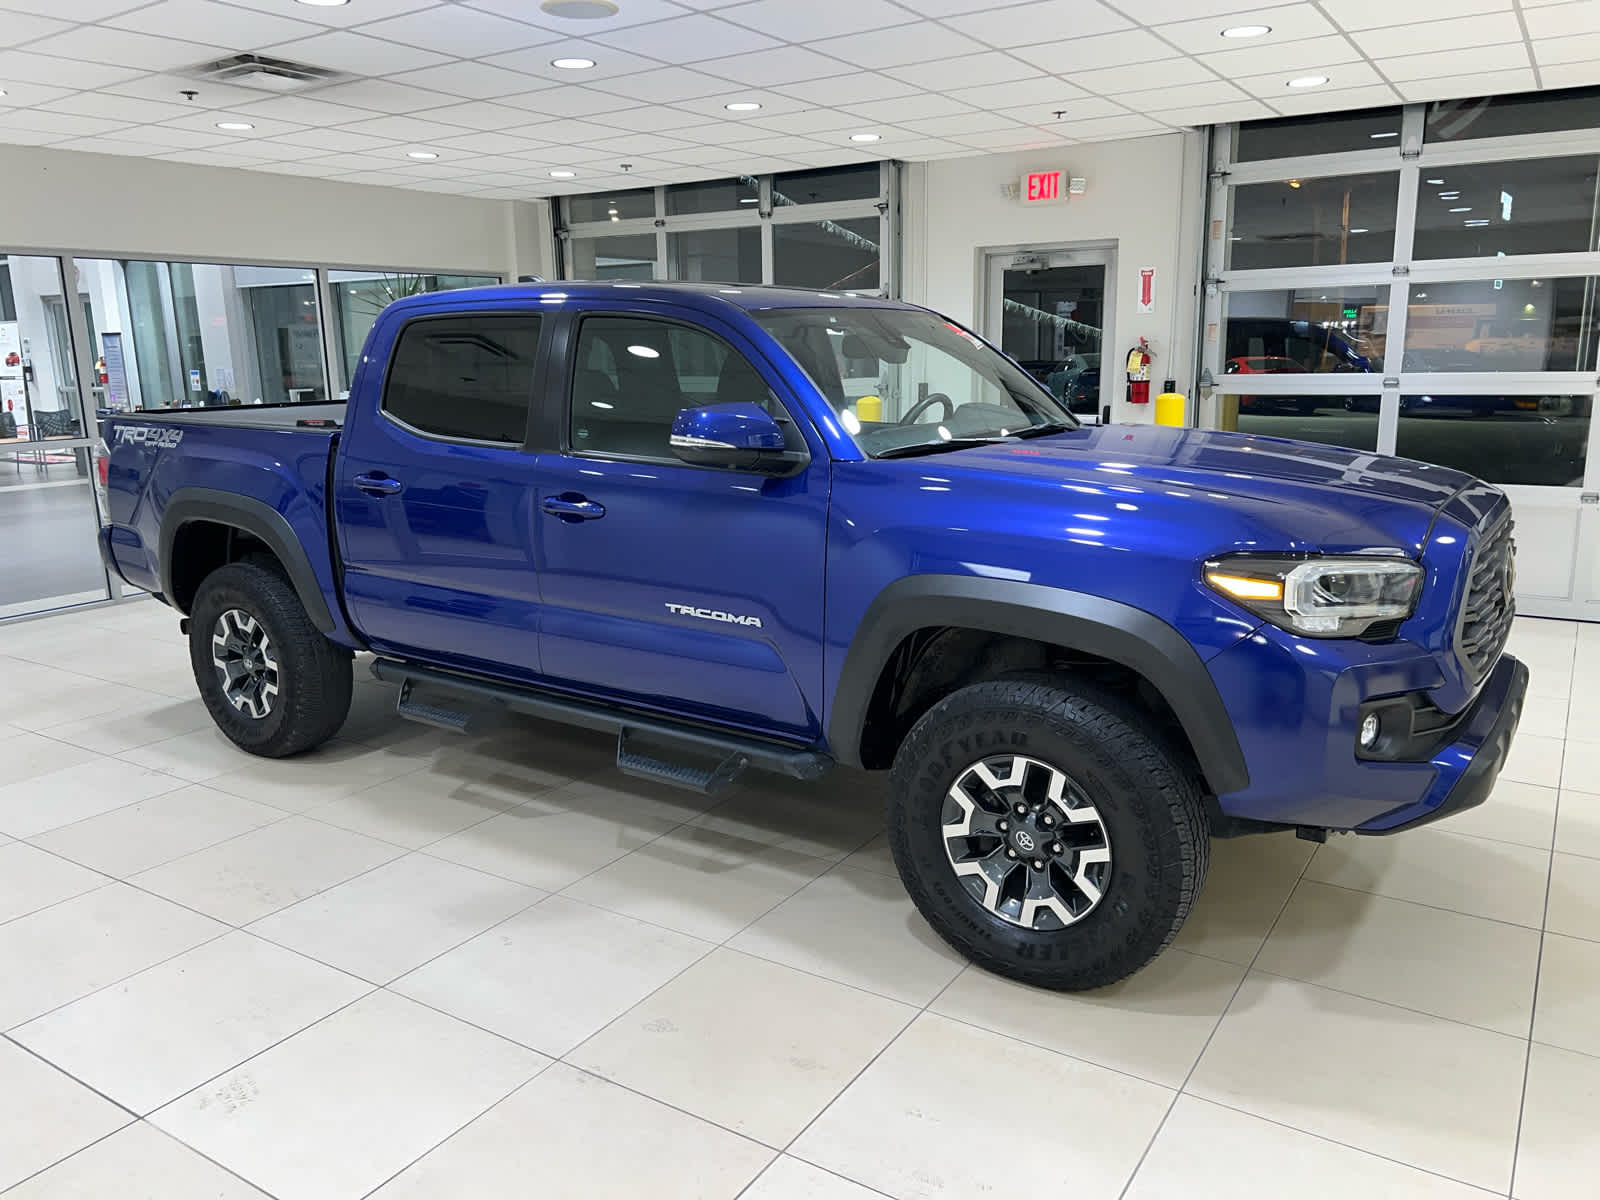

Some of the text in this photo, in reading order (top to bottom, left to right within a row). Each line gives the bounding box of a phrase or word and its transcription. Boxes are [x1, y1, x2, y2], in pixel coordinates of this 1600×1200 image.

[1027, 171, 1061, 201] EXIT
[113, 425, 148, 445] TRD
[664, 603, 762, 628] TACOMA
